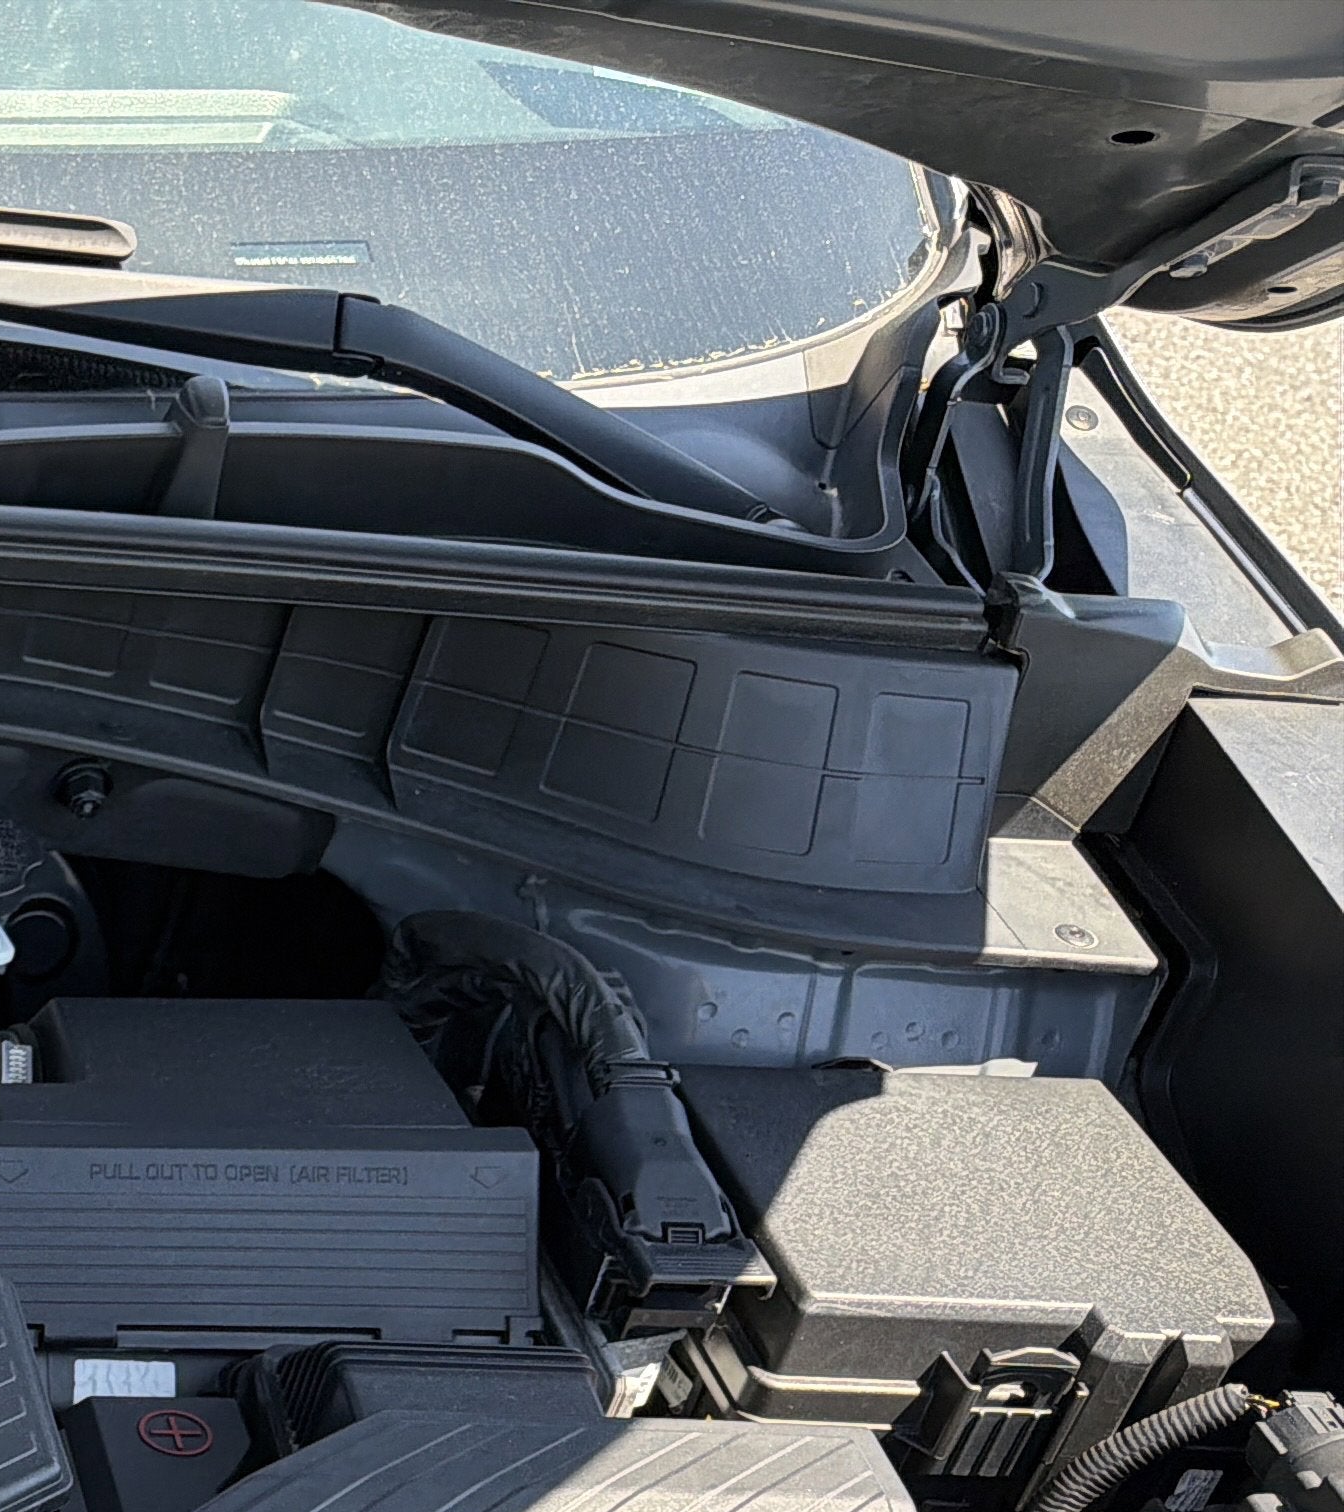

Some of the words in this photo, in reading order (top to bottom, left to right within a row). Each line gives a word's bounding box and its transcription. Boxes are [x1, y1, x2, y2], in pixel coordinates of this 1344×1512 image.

[89, 1163, 141, 1181] PULL
[145, 1163, 188, 1182] OUT
[192, 1163, 218, 1182] TO
[224, 1163, 280, 1183] OPEN
